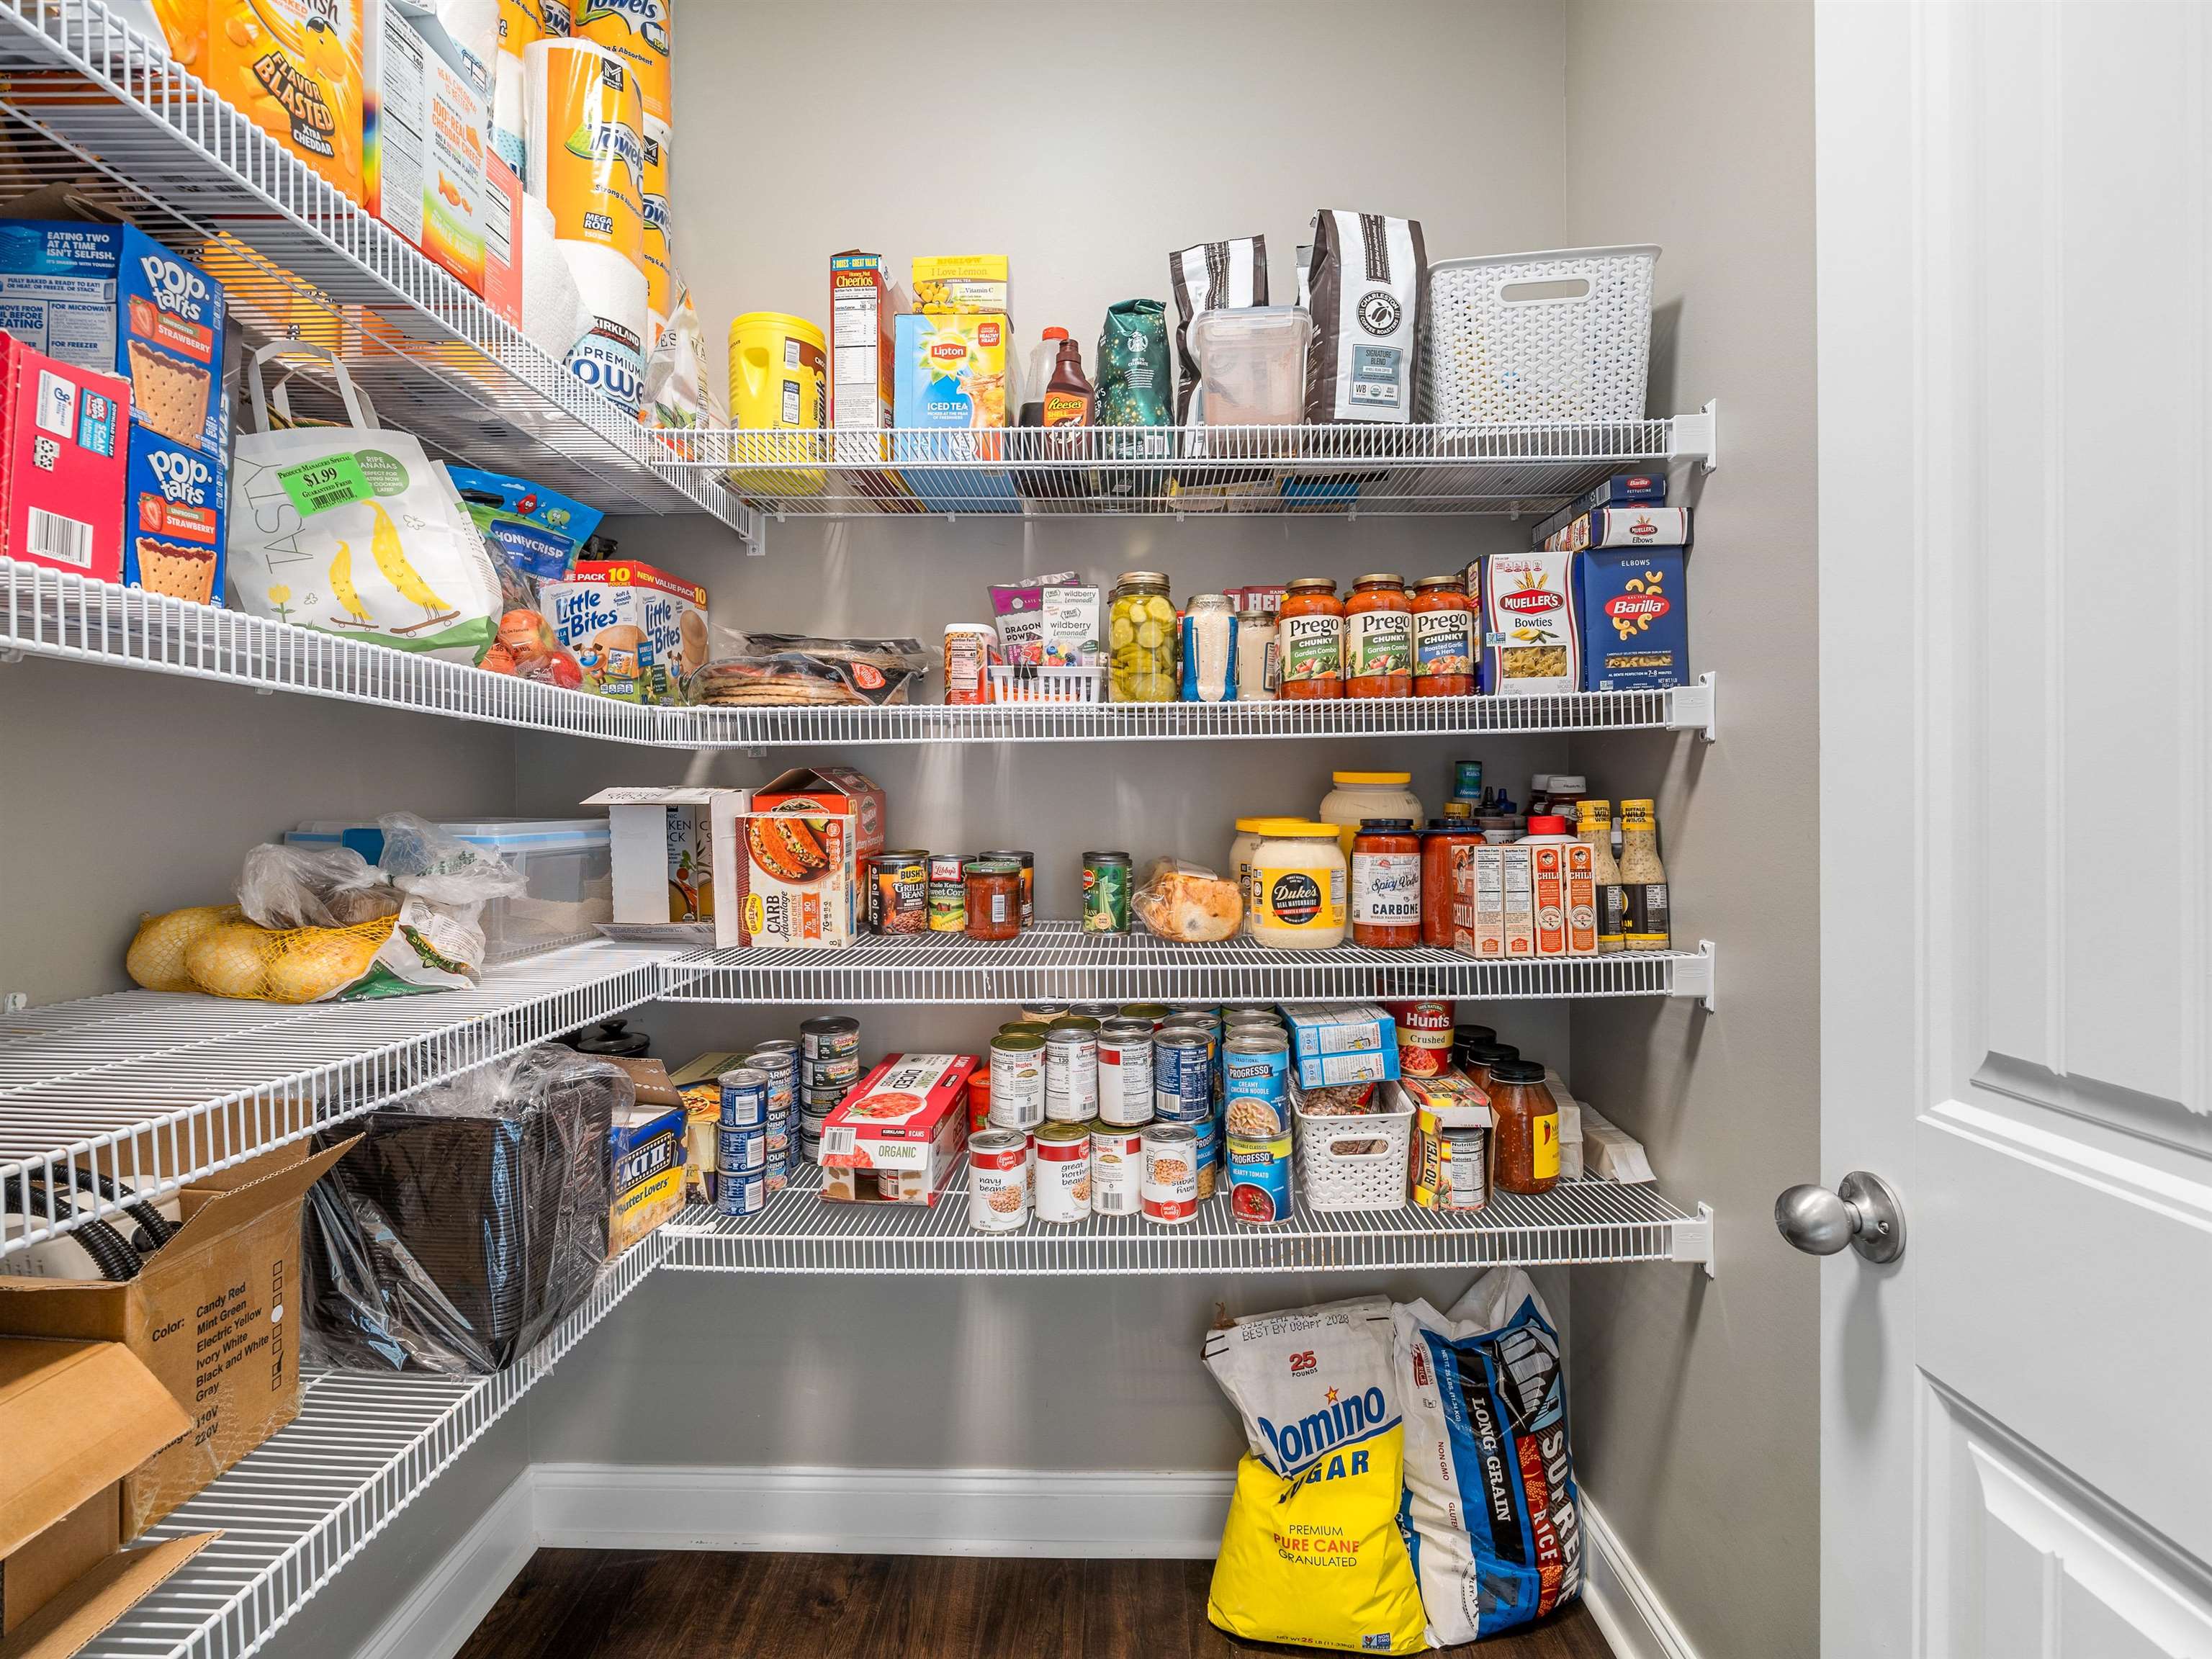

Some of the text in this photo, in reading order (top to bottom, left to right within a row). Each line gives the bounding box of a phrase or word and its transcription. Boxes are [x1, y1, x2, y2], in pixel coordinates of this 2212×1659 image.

[619, 48, 652, 66] Absorbent
[272, 52, 323, 101] FLAVOR
[254, 55, 334, 130] BLASTED
[302, 124, 322, 141] XTRA
[293, 130, 333, 155] CHEDDAR
[585, 213, 612, 225] MEGA
[585, 220, 612, 233] ROLL
[48, 232, 83, 240] EATING
[47, 248, 115, 260] ISN'T SELFISH.
[837, 276, 873, 287] Cheerios
[153, 286, 201, 320] tarts
[1361, 292, 1398, 310] CHARLESTON
[1360, 317, 1398, 335] COFFEE ROASTERS
[158, 325, 210, 353] STRAWBERRY
[935, 347, 963, 356] Lipton
[1366, 350, 1391, 359] SIGNATURE
[585, 347, 641, 376] PREMIUM
[96, 424, 107, 453] SCAN
[303, 468, 337, 487] $1.99
[161, 480, 204, 505] tarts
[167, 516, 215, 534] STRAWBERRY
[495, 531, 563, 559] HONEYCRISP
[608, 568, 630, 582] 10
[637, 572, 706, 605] NEW VALUE PACK 10
[1504, 595, 1560, 610] MUELLER'S
[1614, 601, 1662, 613] Barilla
[572, 610, 618, 637] Bites
[645, 600, 671, 635] Little
[1362, 616, 1409, 633] Prego
[1417, 613, 1467, 633] Prego
[1515, 618, 1552, 627] Bowties
[1005, 622, 1040, 634] DRAGON
[1290, 619, 1339, 637] Prego
[655, 626, 680, 653] Bites
[1299, 638, 1332, 647] CHUNKY
[1372, 634, 1404, 643] CHUNKY
[1424, 633, 1463, 644] CHUNKY
[1295, 649, 1316, 658] Garden
[1367, 645, 1389, 654] Garden
[1424, 644, 1447, 652] Roasted
[935, 866, 956, 875] Libby's
[1274, 885, 1316, 900] Duke's
[1372, 878, 1398, 894] Spicy
[767, 895, 780, 933] CARB
[804, 902, 811, 912] 90
[1373, 904, 1418, 914] CARBONE
[780, 891, 791, 942] Advantage
[1406, 1013, 1449, 1028] Hunt's
[1410, 1035, 1445, 1044] Crushed
[893, 1070, 922, 1089] DICED
[1230, 1067, 1269, 1077] PROGRESSO
[879, 1146, 916, 1158] ORGANIC
[621, 1155, 649, 1187] ACT
[1061, 1163, 1083, 1172] great
[197, 1282, 246, 1318] Candy Red
[197, 1301, 246, 1335] Mint Green
[152, 1318, 184, 1342] Color:
[197, 1308, 261, 1353] Electric Yellow
[1243, 1326, 1269, 1341] BEST
[1272, 1323, 1287, 1334] BY
[1326, 1314, 1349, 1326] 2028
[197, 1333, 248, 1370] Ivory White
[197, 1336, 269, 1388] Black and White
[1290, 1351, 1316, 1371] 25
[1292, 1368, 1318, 1377] POUNDS
[197, 1382, 219, 1402] Gray
[195, 1423, 219, 1446] 220V
[1472, 1398, 1510, 1521] LONG GRAIN
[1440, 1461, 1449, 1480] GMO
[1290, 1524, 1343, 1536] PREMIUM
[1533, 1509, 1557, 1560] RICE
[1273, 1534, 1359, 1553] PURE CANE
[1279, 1549, 1357, 1567] GRANULATED
